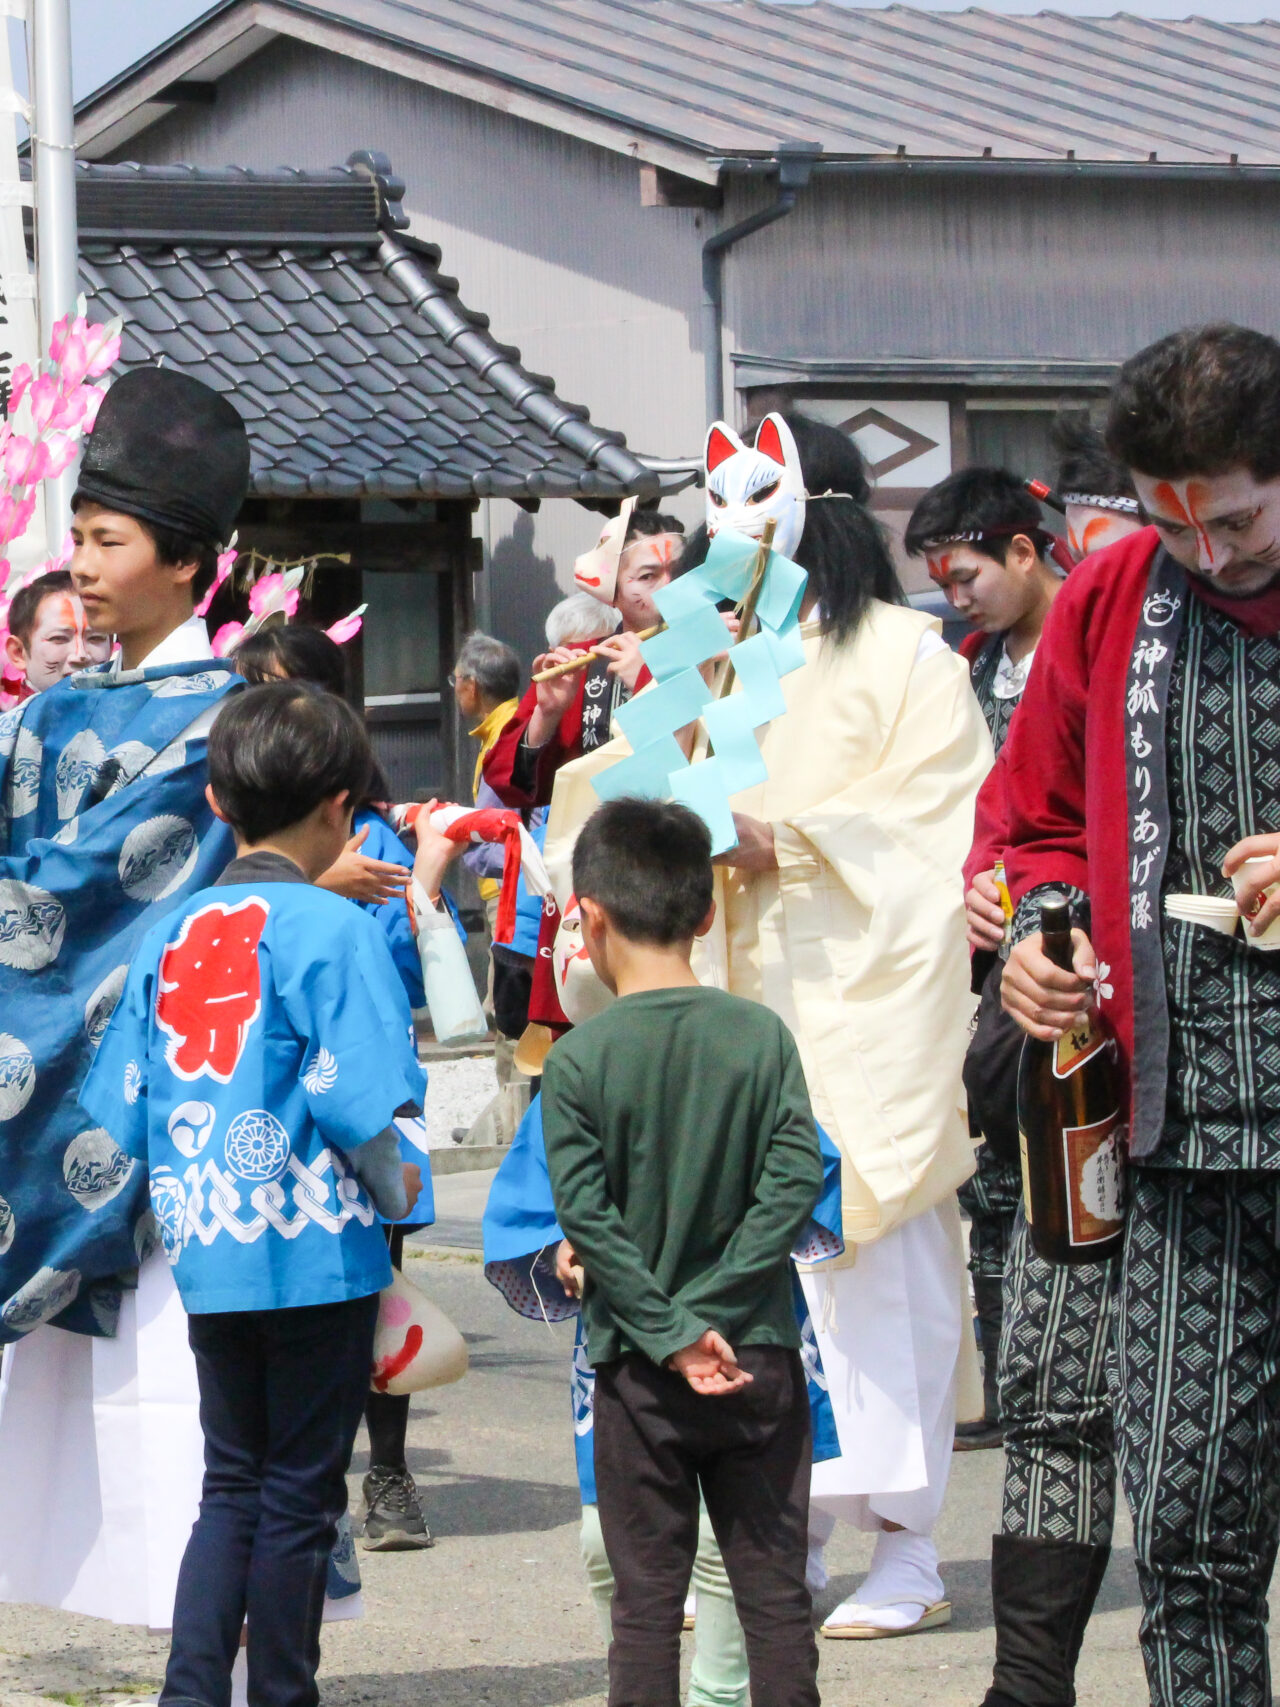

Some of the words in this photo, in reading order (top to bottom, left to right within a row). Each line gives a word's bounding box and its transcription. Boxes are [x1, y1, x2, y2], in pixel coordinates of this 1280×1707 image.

[1126, 639, 1169, 931] 神狐もりあげ隊
